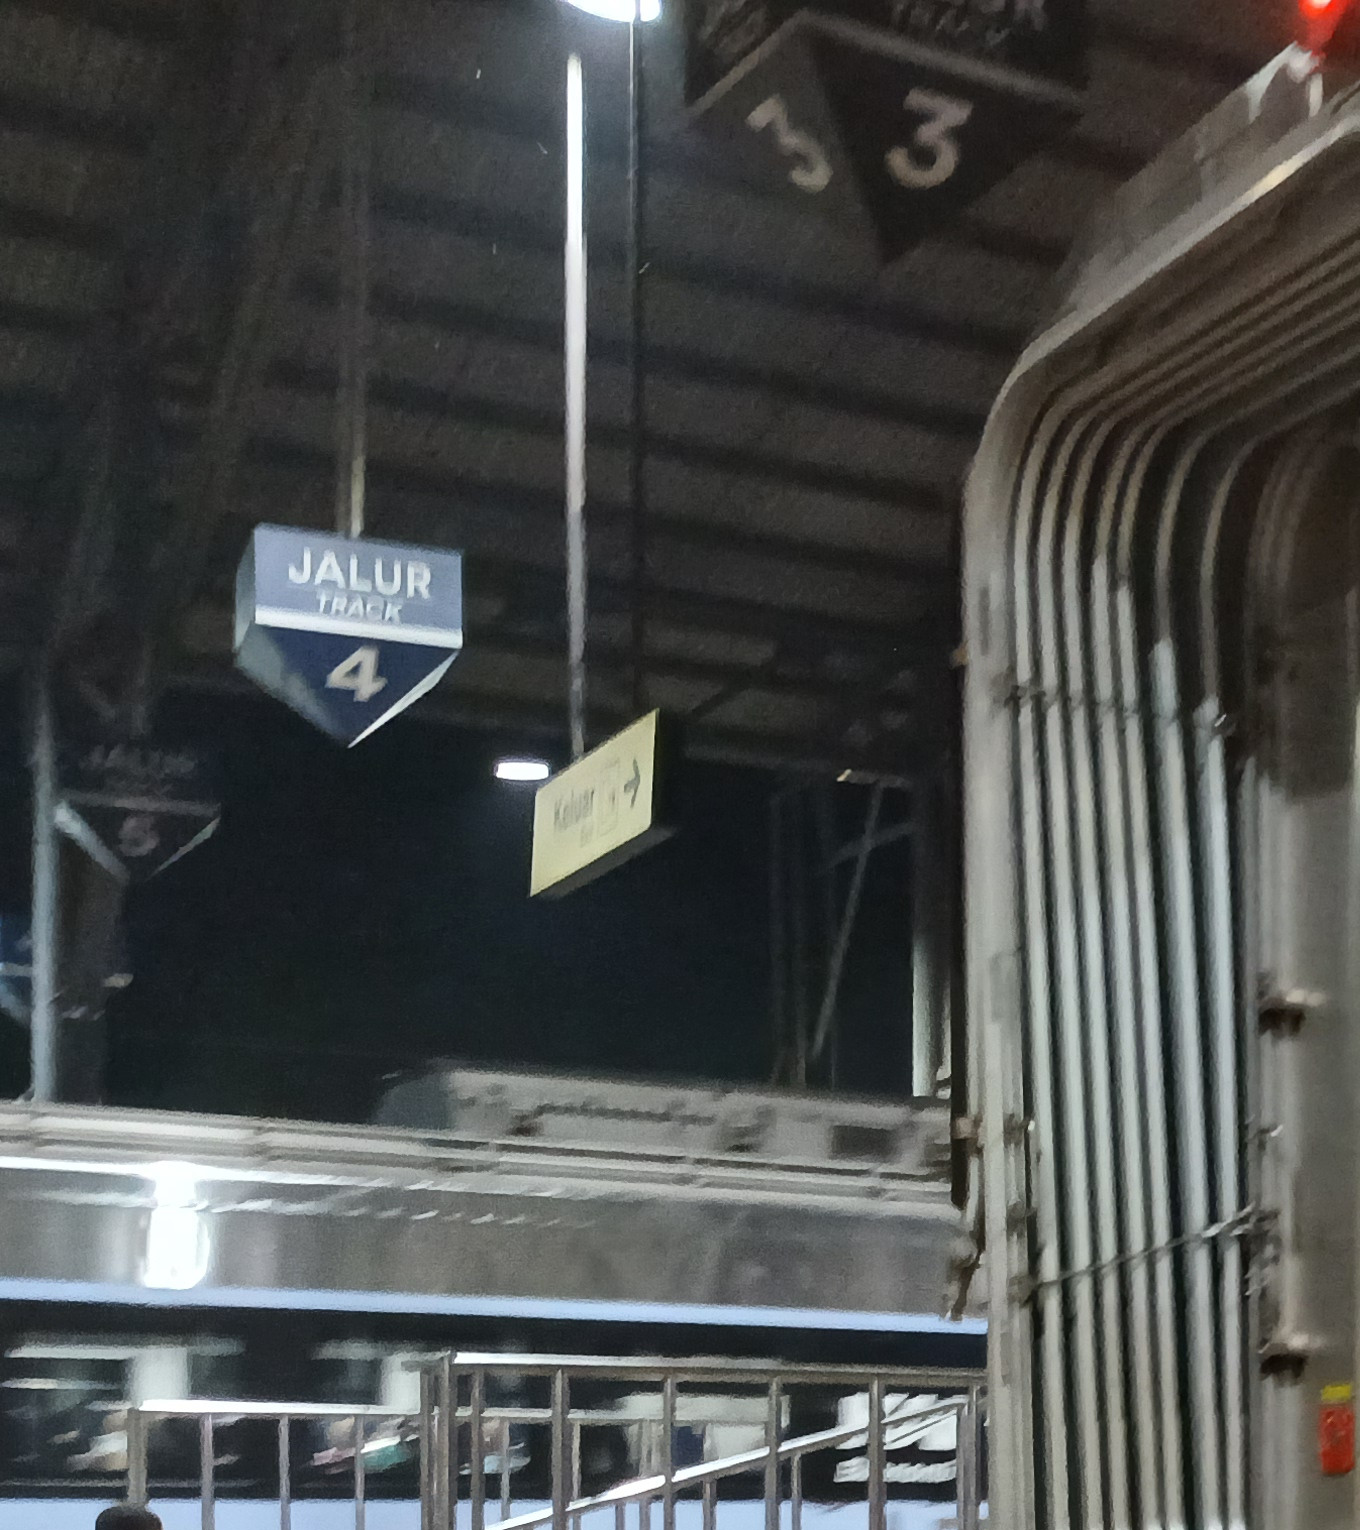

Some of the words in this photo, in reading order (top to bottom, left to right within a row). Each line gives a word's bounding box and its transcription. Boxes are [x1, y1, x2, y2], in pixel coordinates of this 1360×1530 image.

[883, 86, 973, 190] 3
[288, 547, 432, 600] JALUR
[316, 590, 403, 623] TRACK
[325, 646, 388, 702] 4
